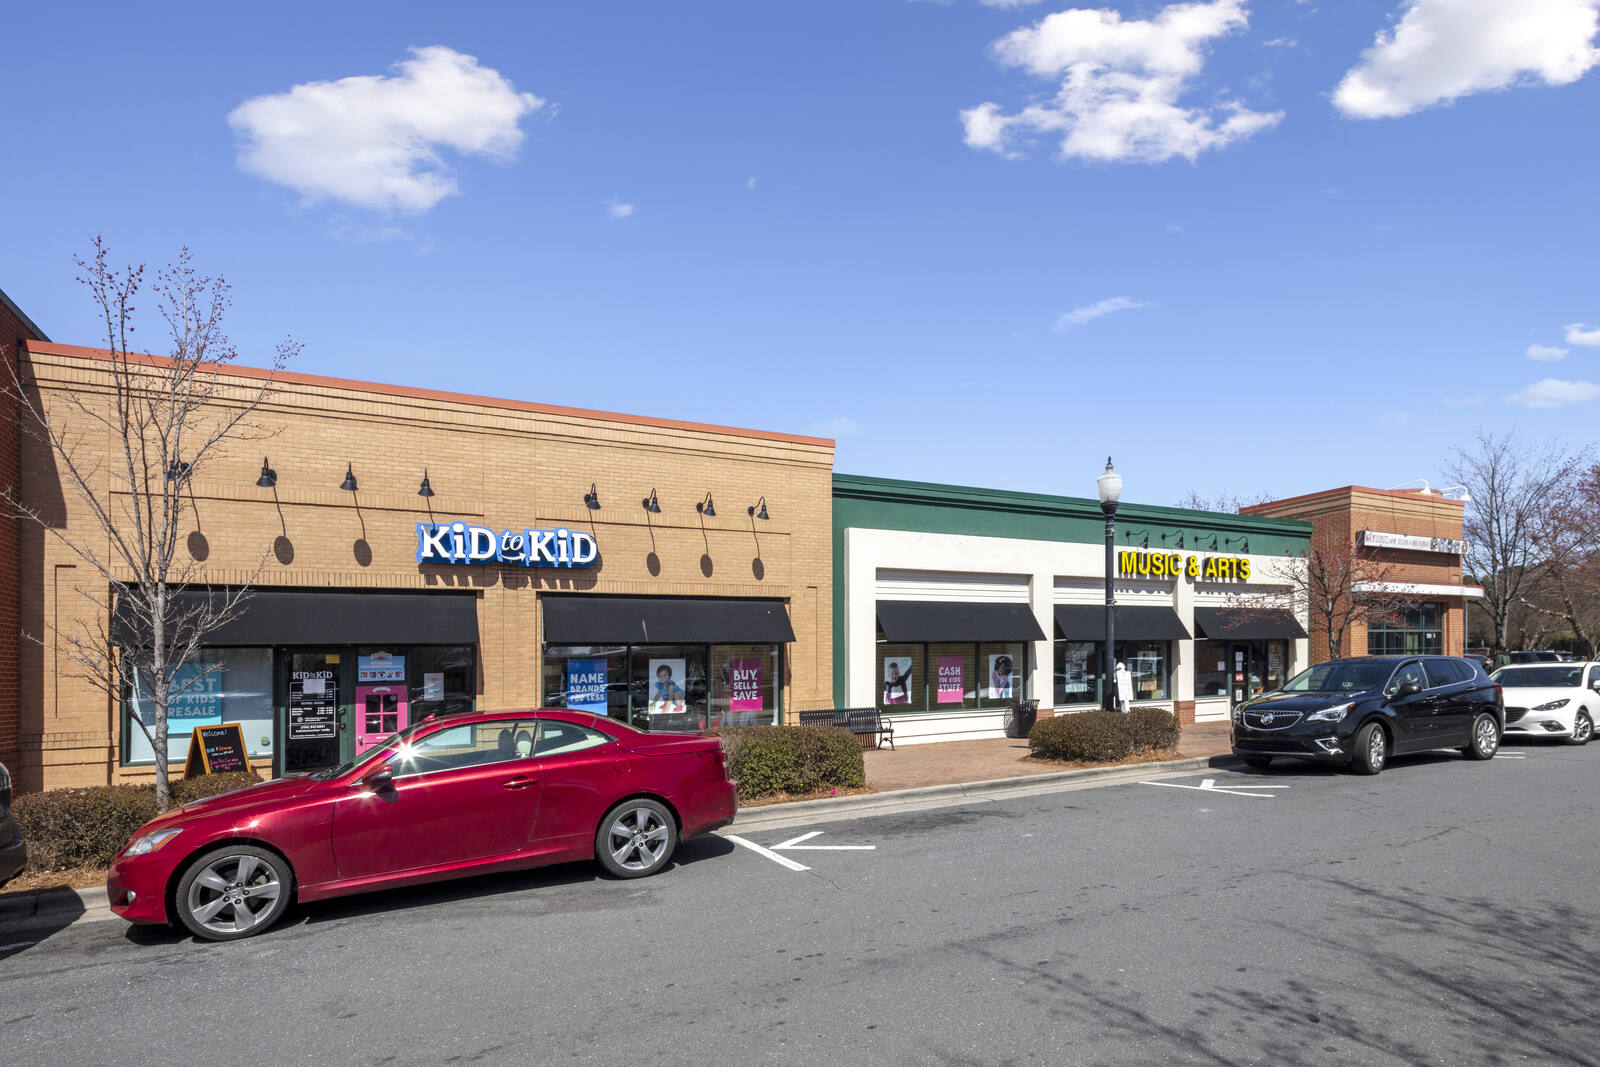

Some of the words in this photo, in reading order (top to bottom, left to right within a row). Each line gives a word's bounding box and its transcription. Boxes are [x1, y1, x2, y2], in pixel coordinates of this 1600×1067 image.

[420, 523, 497, 559] KiD
[501, 531, 524, 551] to
[528, 528, 598, 563] KiD
[1121, 551, 1183, 576] MUSIC
[1188, 555, 1201, 577] &
[1205, 556, 1251, 579] ARTS
[939, 666, 961, 676] CASH
[570, 673, 605, 684] NAME
[570, 684, 605, 693] BRANDS
[733, 681, 751, 690] SELL
[751, 681, 758, 690] &
[939, 683, 961, 692] STUFF
[187, 693, 217, 704] KIDS
[586, 692, 605, 701] LESS
[733, 690, 758, 700] SAVE
[168, 705, 216, 717] RESALE
